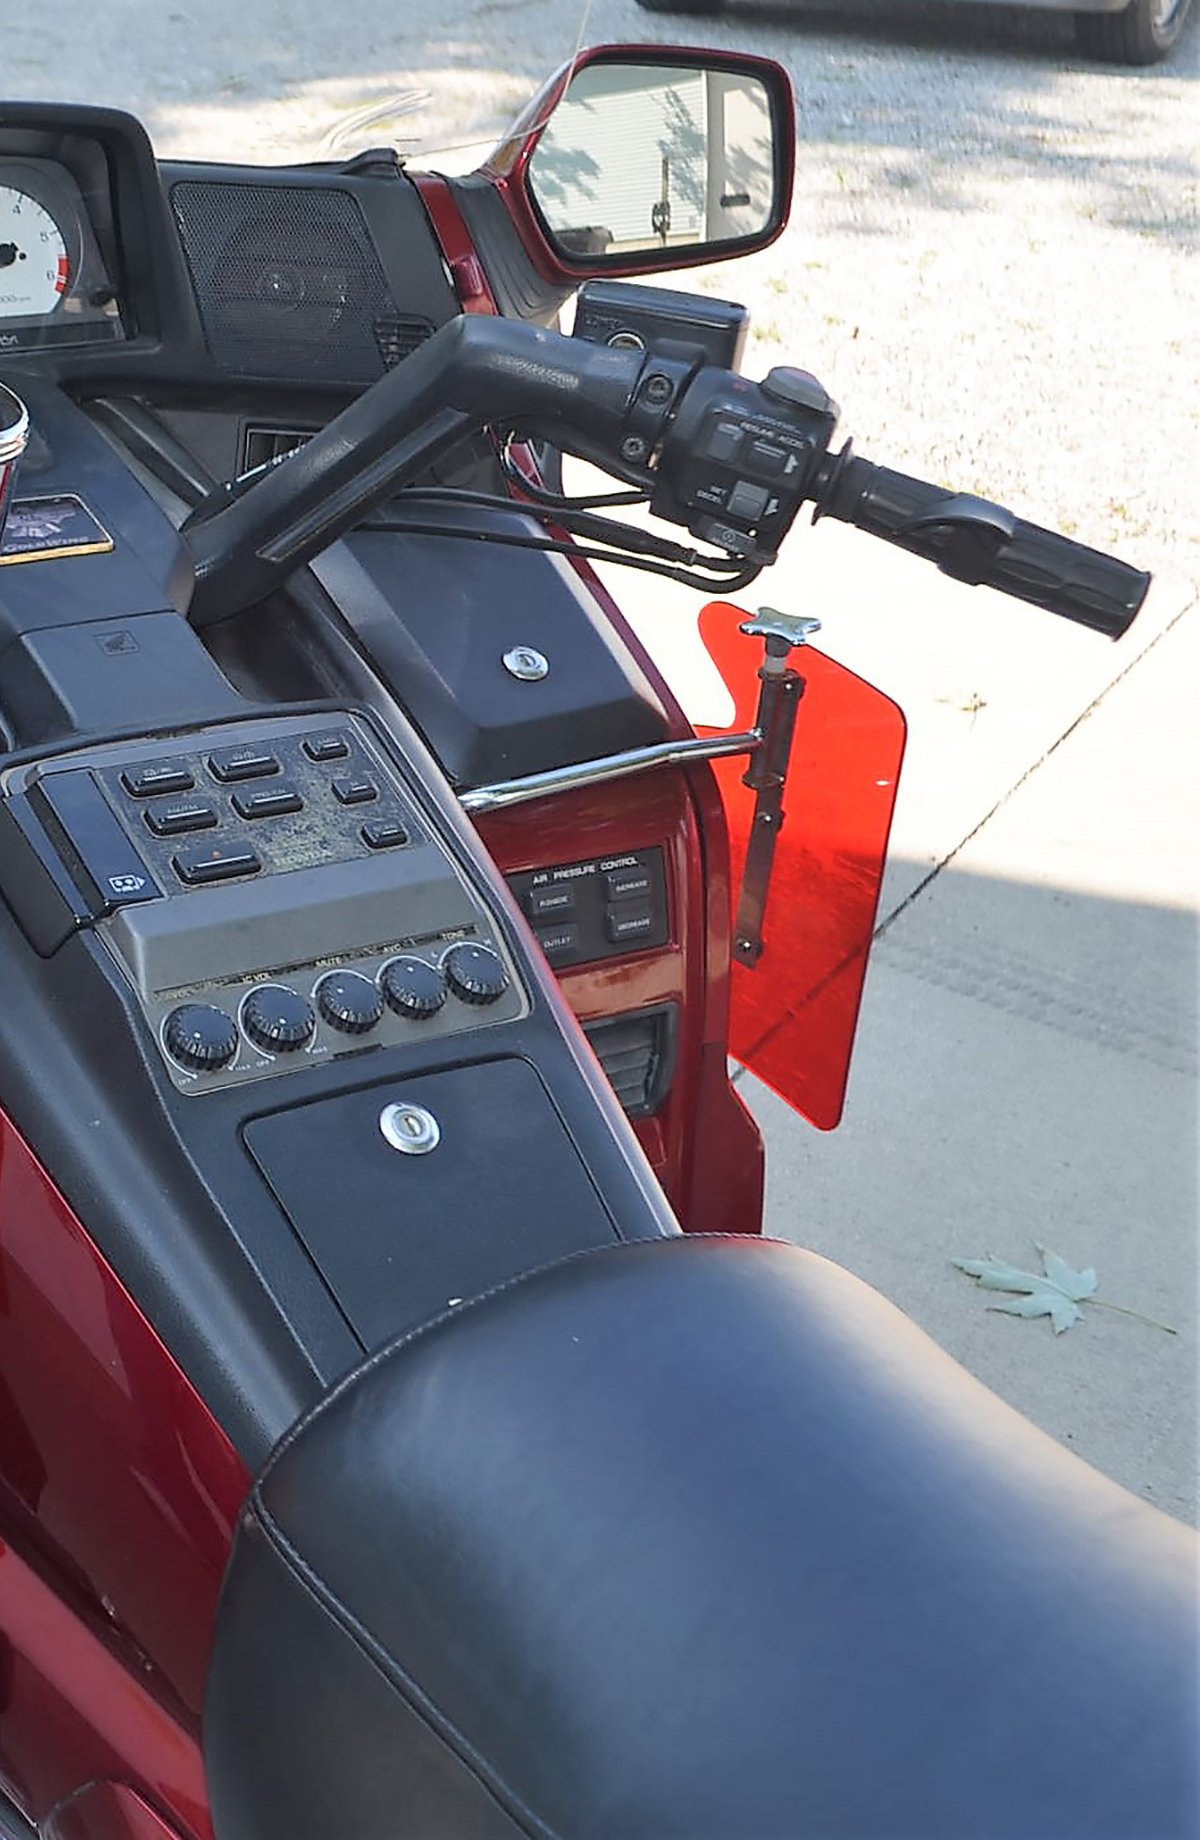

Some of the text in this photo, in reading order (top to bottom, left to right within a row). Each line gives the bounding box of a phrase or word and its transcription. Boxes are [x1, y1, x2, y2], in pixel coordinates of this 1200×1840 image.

[533, 855, 639, 884] AIR PRESSURE CONTROL
